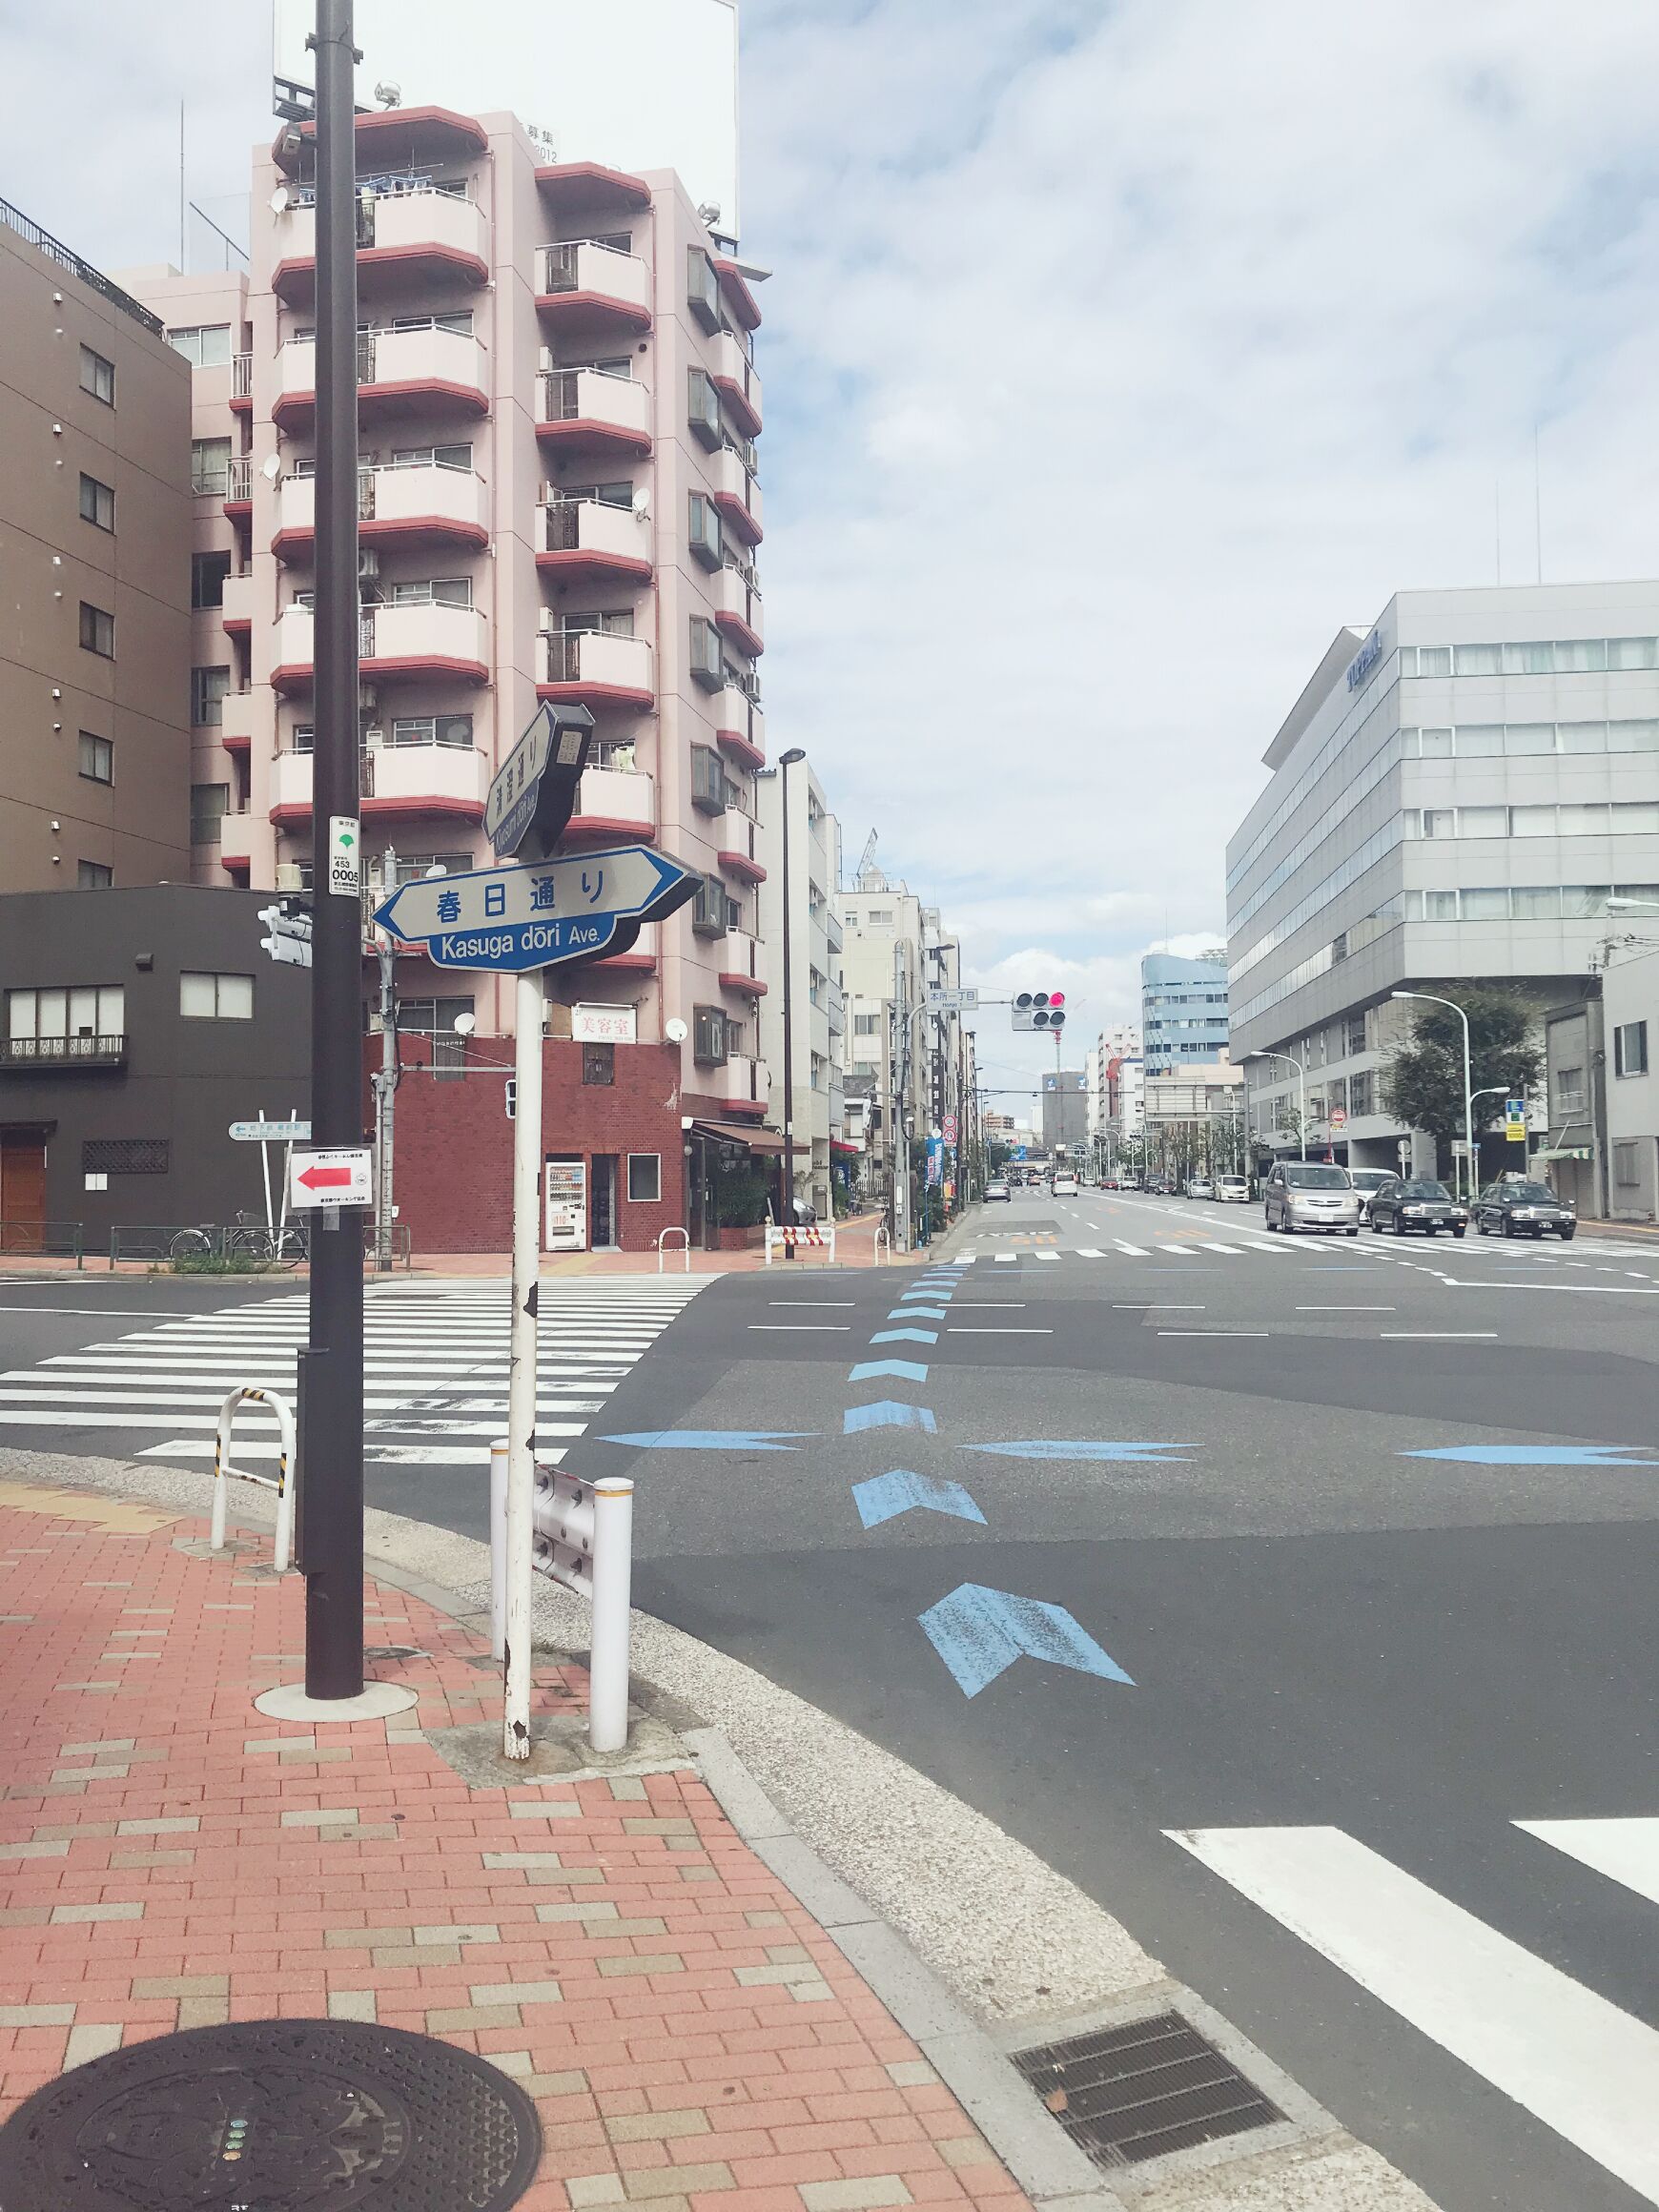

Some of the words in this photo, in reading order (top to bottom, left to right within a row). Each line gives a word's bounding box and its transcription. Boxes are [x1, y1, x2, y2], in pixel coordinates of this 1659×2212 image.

[335, 860, 350, 869] 453
[332, 870, 358, 882] 0005
[437, 870, 603, 923] 春日通り
[441, 934, 514, 959] Kasuga
[521, 923, 560, 951] dōri
[568, 925, 601, 945] Ave.
[930, 992, 974, 1001] 本所一丁目
[582, 1016, 629, 1035] 美容室
